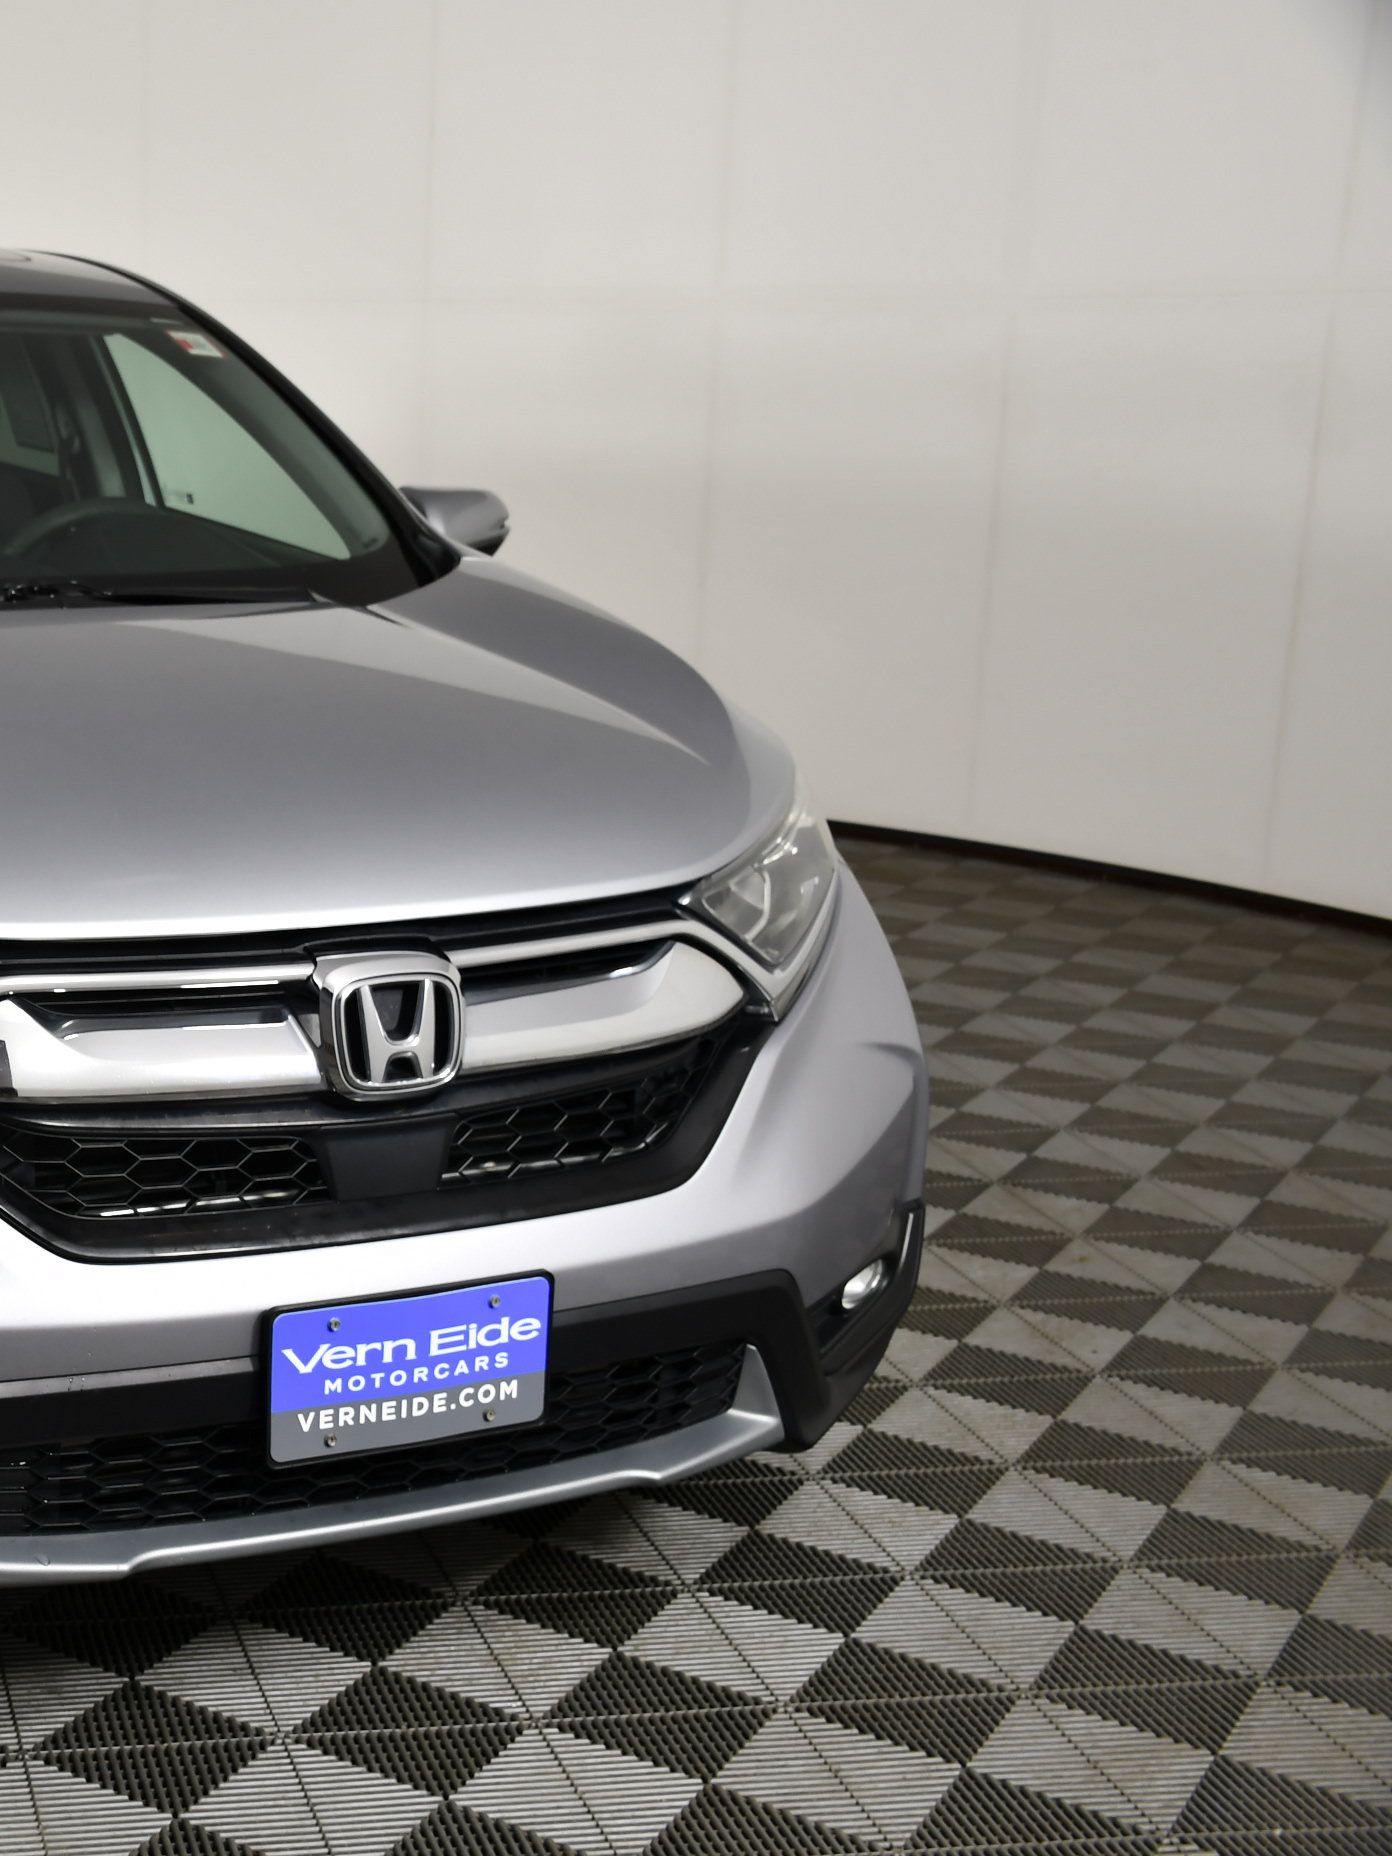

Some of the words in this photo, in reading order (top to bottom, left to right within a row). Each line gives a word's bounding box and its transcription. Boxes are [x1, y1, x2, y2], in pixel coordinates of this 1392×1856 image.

[281, 1337, 417, 1374] Vern
[429, 1316, 541, 1357] Eide
[324, 1352, 509, 1395] MOTORCARS
[297, 1379, 519, 1433] VERNEIDE.COM
